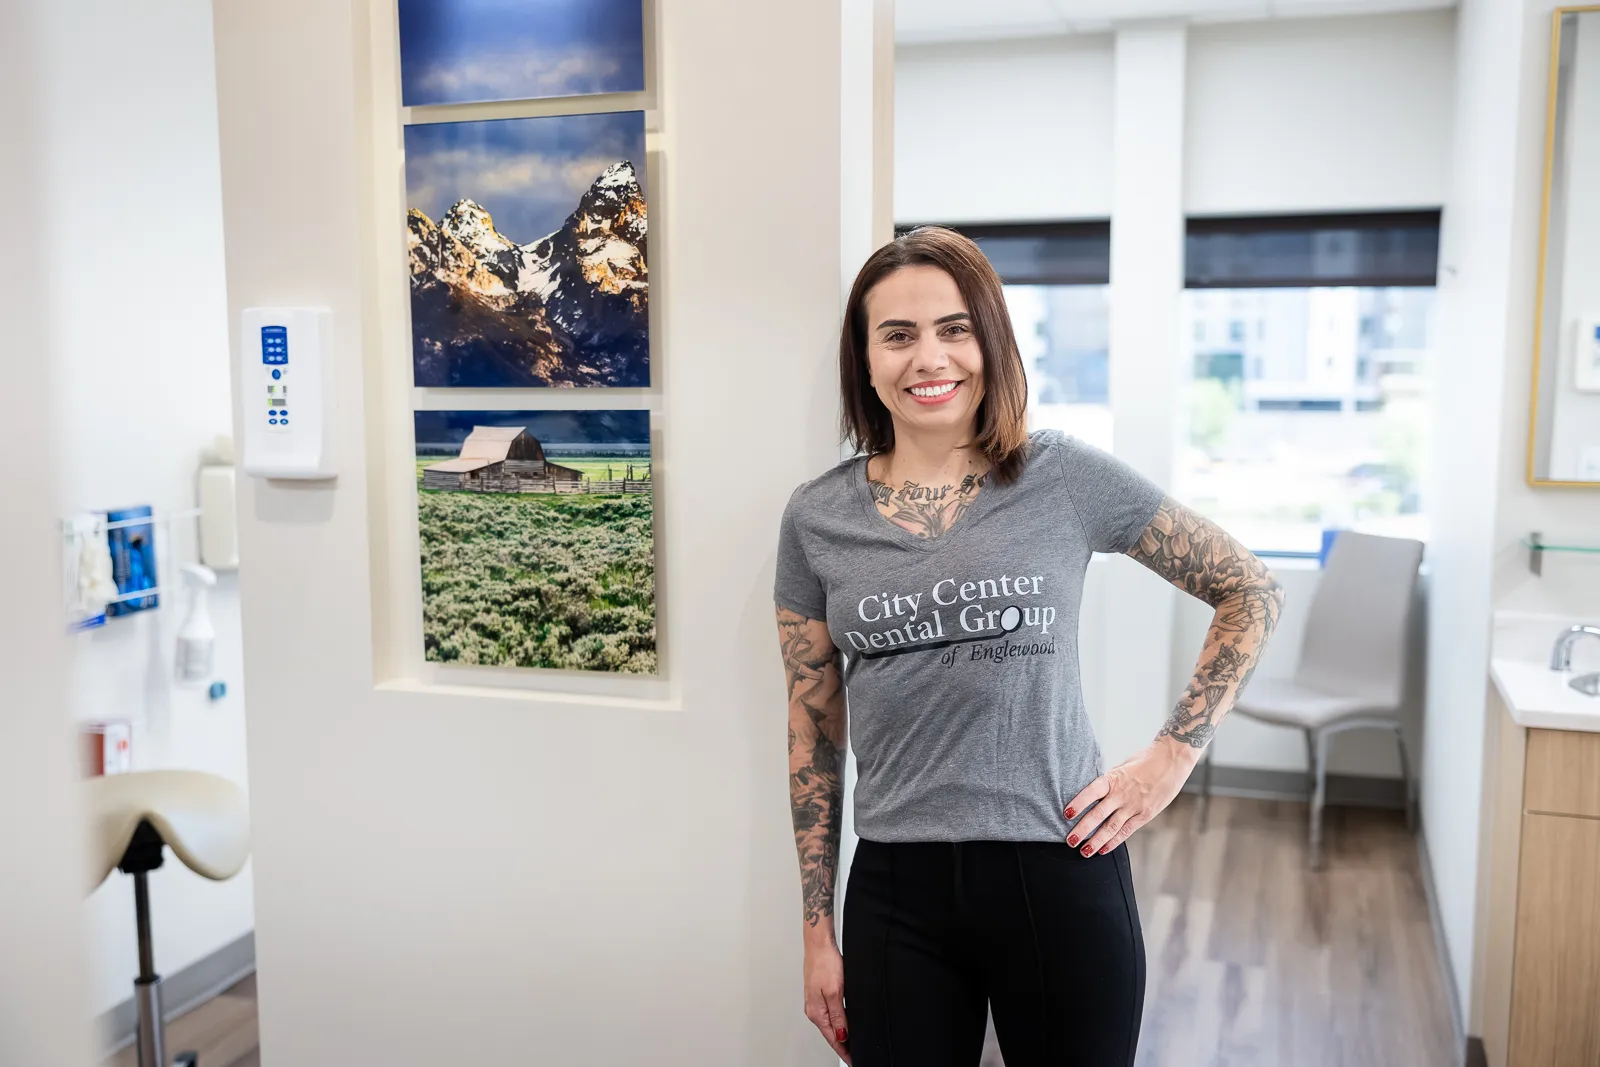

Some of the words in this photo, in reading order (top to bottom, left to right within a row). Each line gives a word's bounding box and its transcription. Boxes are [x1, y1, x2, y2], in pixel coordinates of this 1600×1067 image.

[858, 592, 923, 622] City
[932, 574, 1043, 606] Center
[844, 610, 945, 651] Dental
[959, 604, 1056, 635] Group
[941, 646, 960, 668] of
[970, 637, 1056, 664] Englewood
